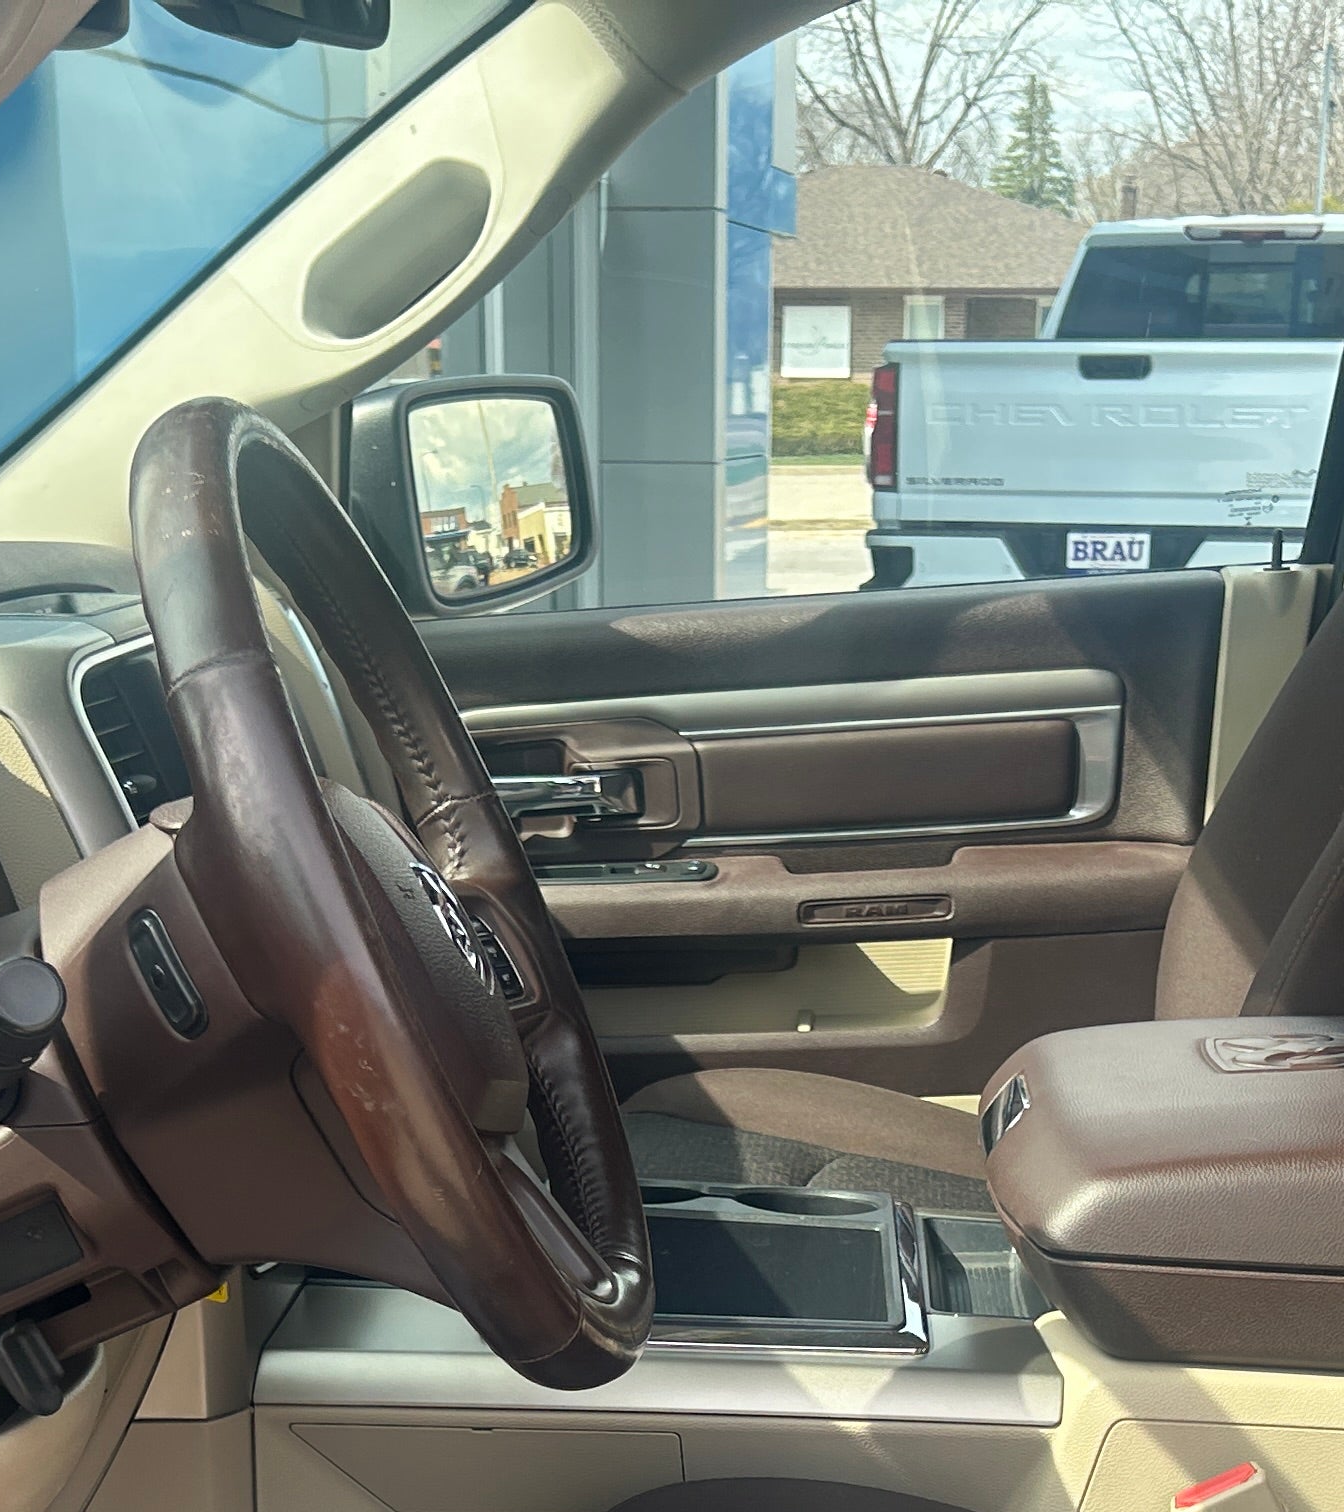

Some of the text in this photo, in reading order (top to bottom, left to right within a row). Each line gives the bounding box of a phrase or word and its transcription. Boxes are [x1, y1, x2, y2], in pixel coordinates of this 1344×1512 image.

[924, 402, 1311, 429] CHEVROLET
[1071, 539, 1145, 561] BRAU
[844, 903, 909, 918] RAM
